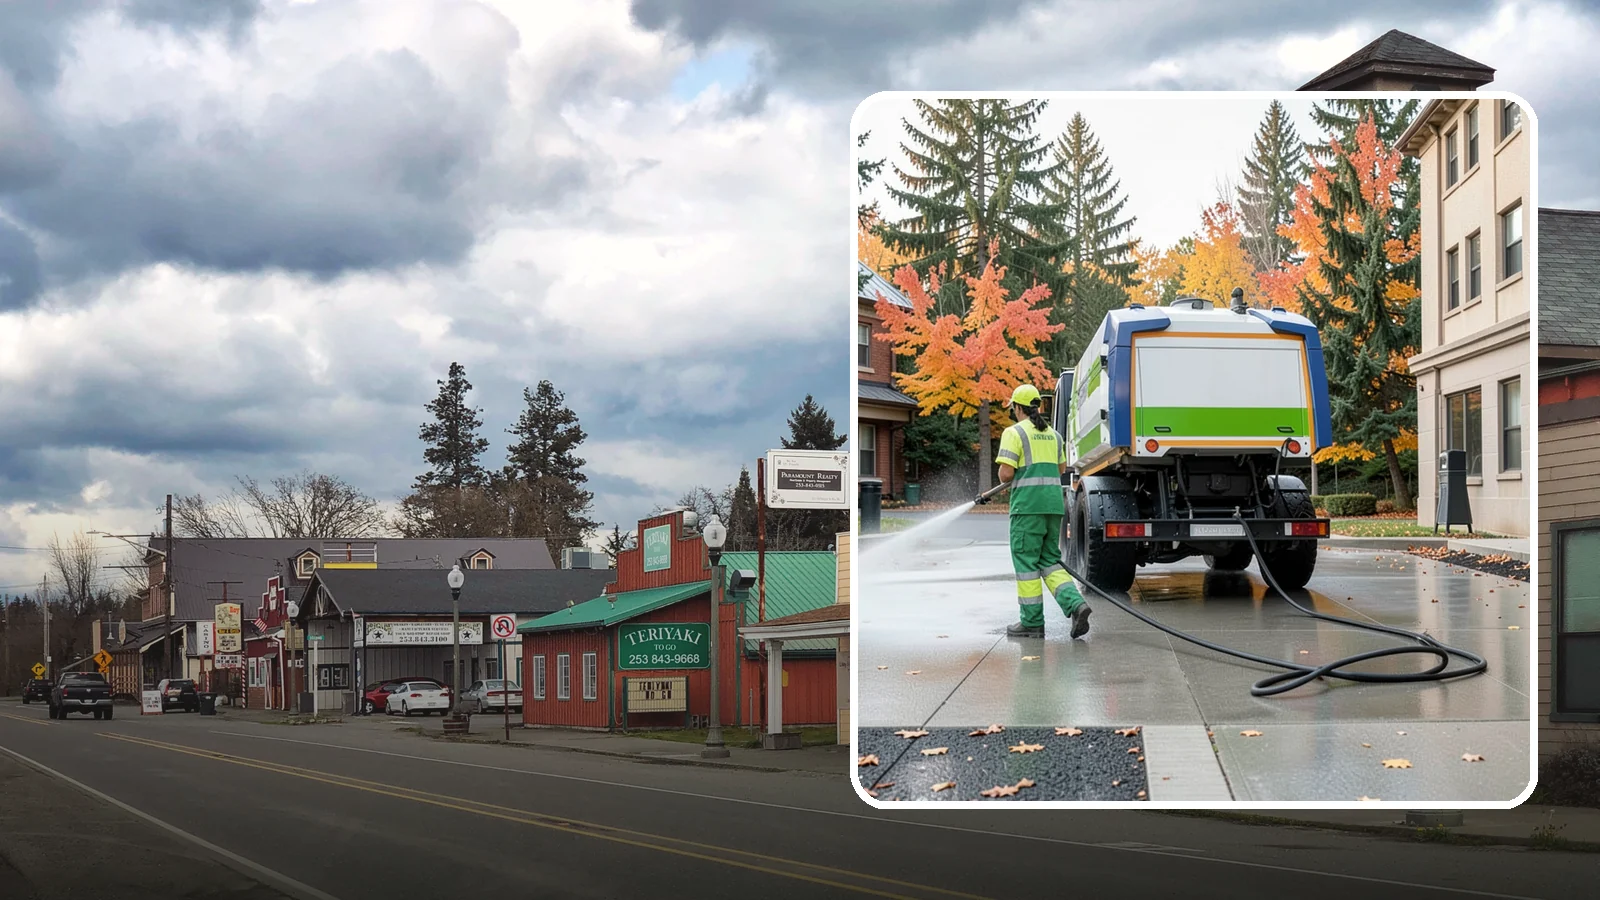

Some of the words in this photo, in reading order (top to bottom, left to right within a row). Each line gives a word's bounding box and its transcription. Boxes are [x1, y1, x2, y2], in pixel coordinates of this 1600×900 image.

[624, 627, 702, 646] TERIYAKI
[628, 654, 648, 664] 253
[652, 654, 700, 664] 843-9668
